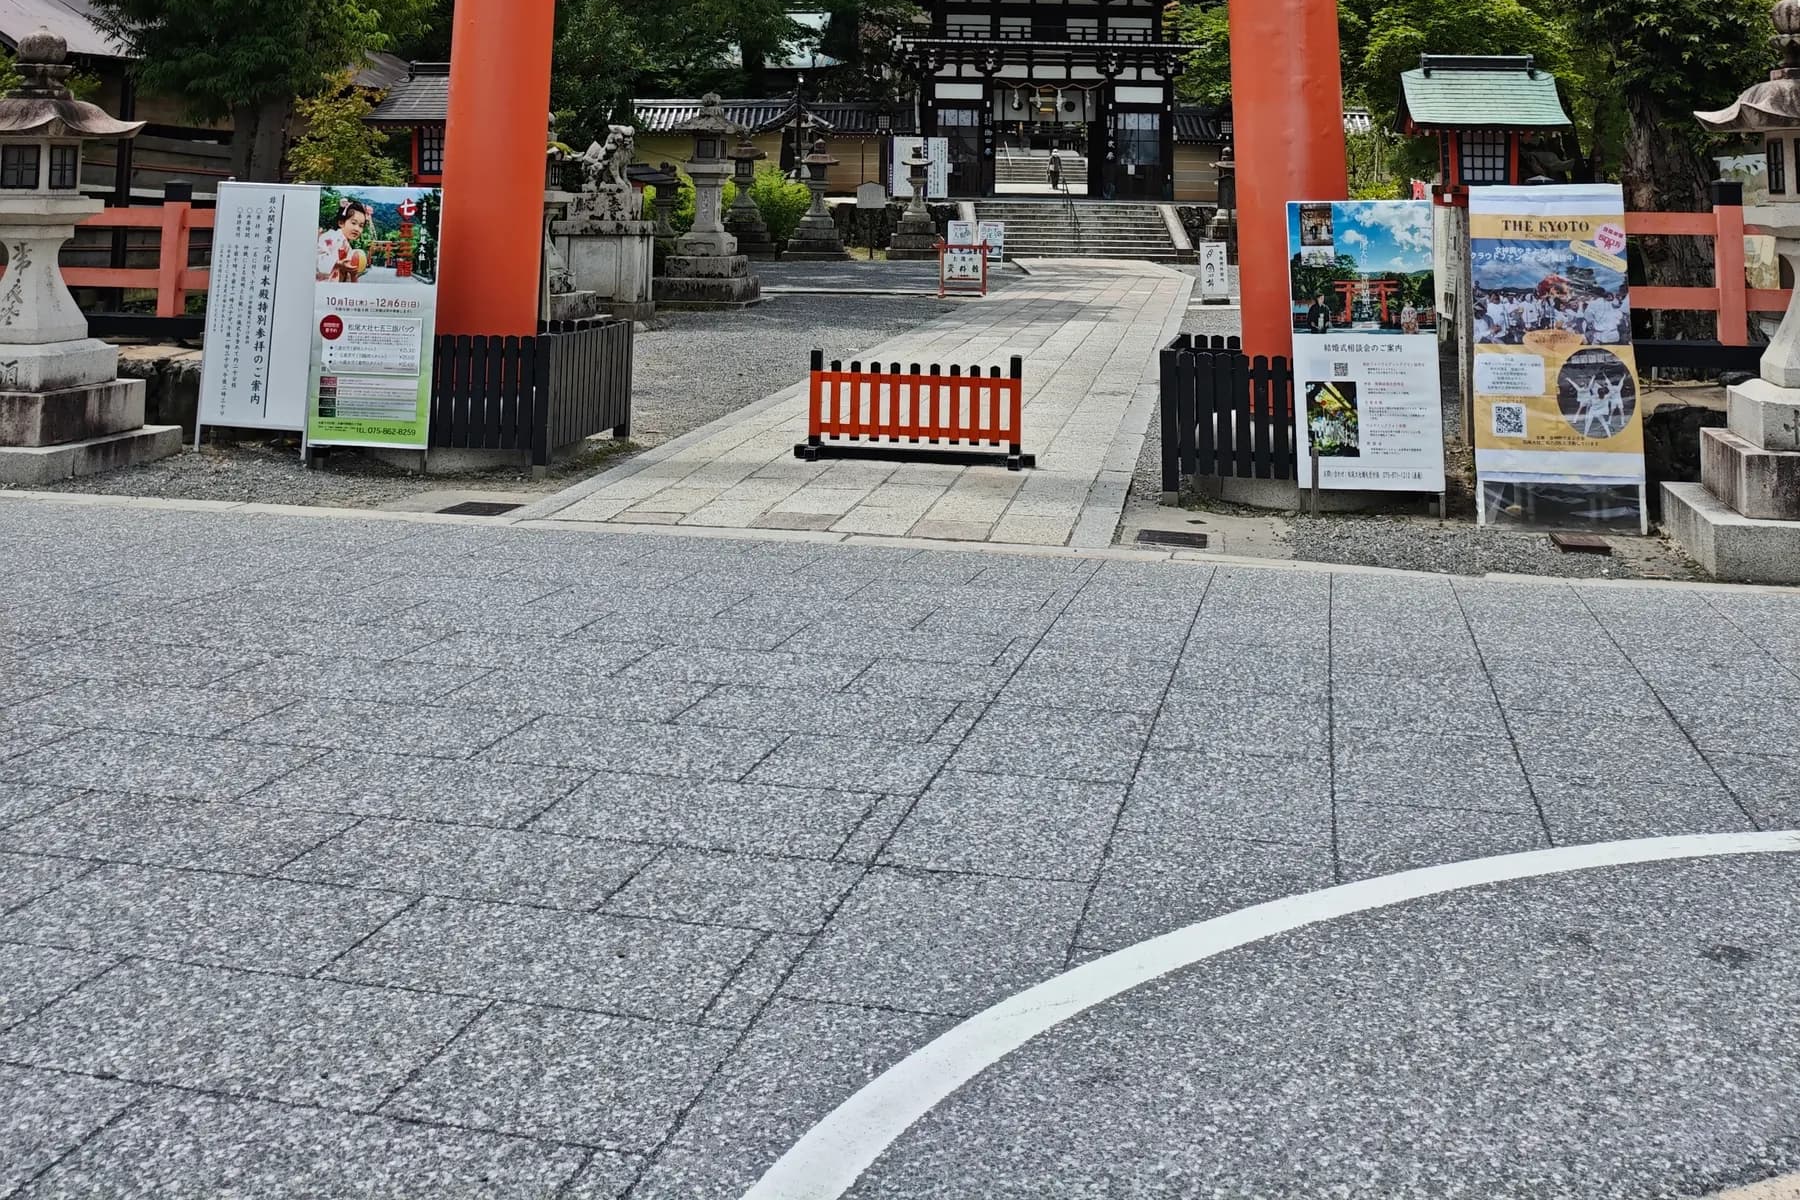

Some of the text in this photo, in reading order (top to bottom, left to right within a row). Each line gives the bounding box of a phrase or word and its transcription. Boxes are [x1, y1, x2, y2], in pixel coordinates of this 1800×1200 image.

[1503, 220, 1589, 233] THE KYOTO
[1324, 343, 1403, 353] 結婚式相談会のご案内
